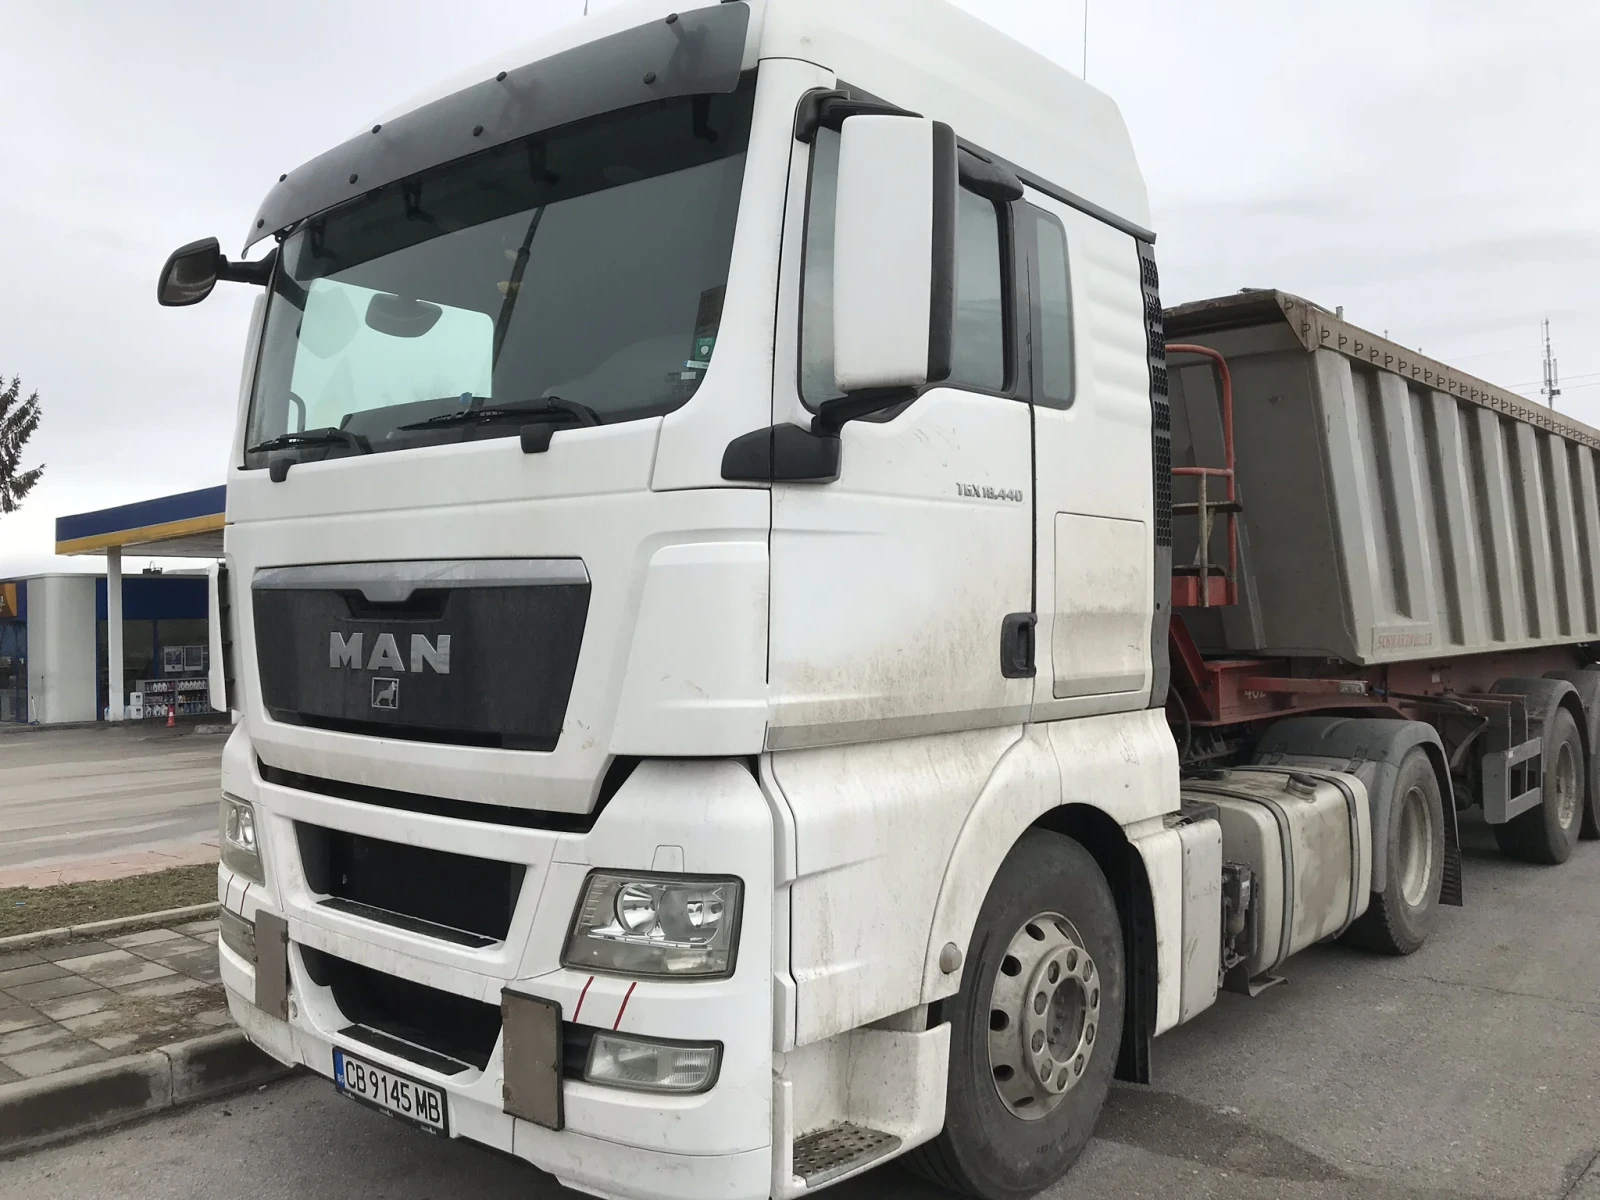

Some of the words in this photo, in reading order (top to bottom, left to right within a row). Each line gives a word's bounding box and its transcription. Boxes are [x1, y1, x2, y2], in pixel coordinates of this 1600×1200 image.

[956, 482, 981, 498] TGX
[982, 485, 1024, 502] 18.440
[329, 631, 451, 674] MAN
[345, 1060, 367, 1094] CB
[369, 1071, 412, 1112] 9145
[414, 1086, 441, 1123] MB
